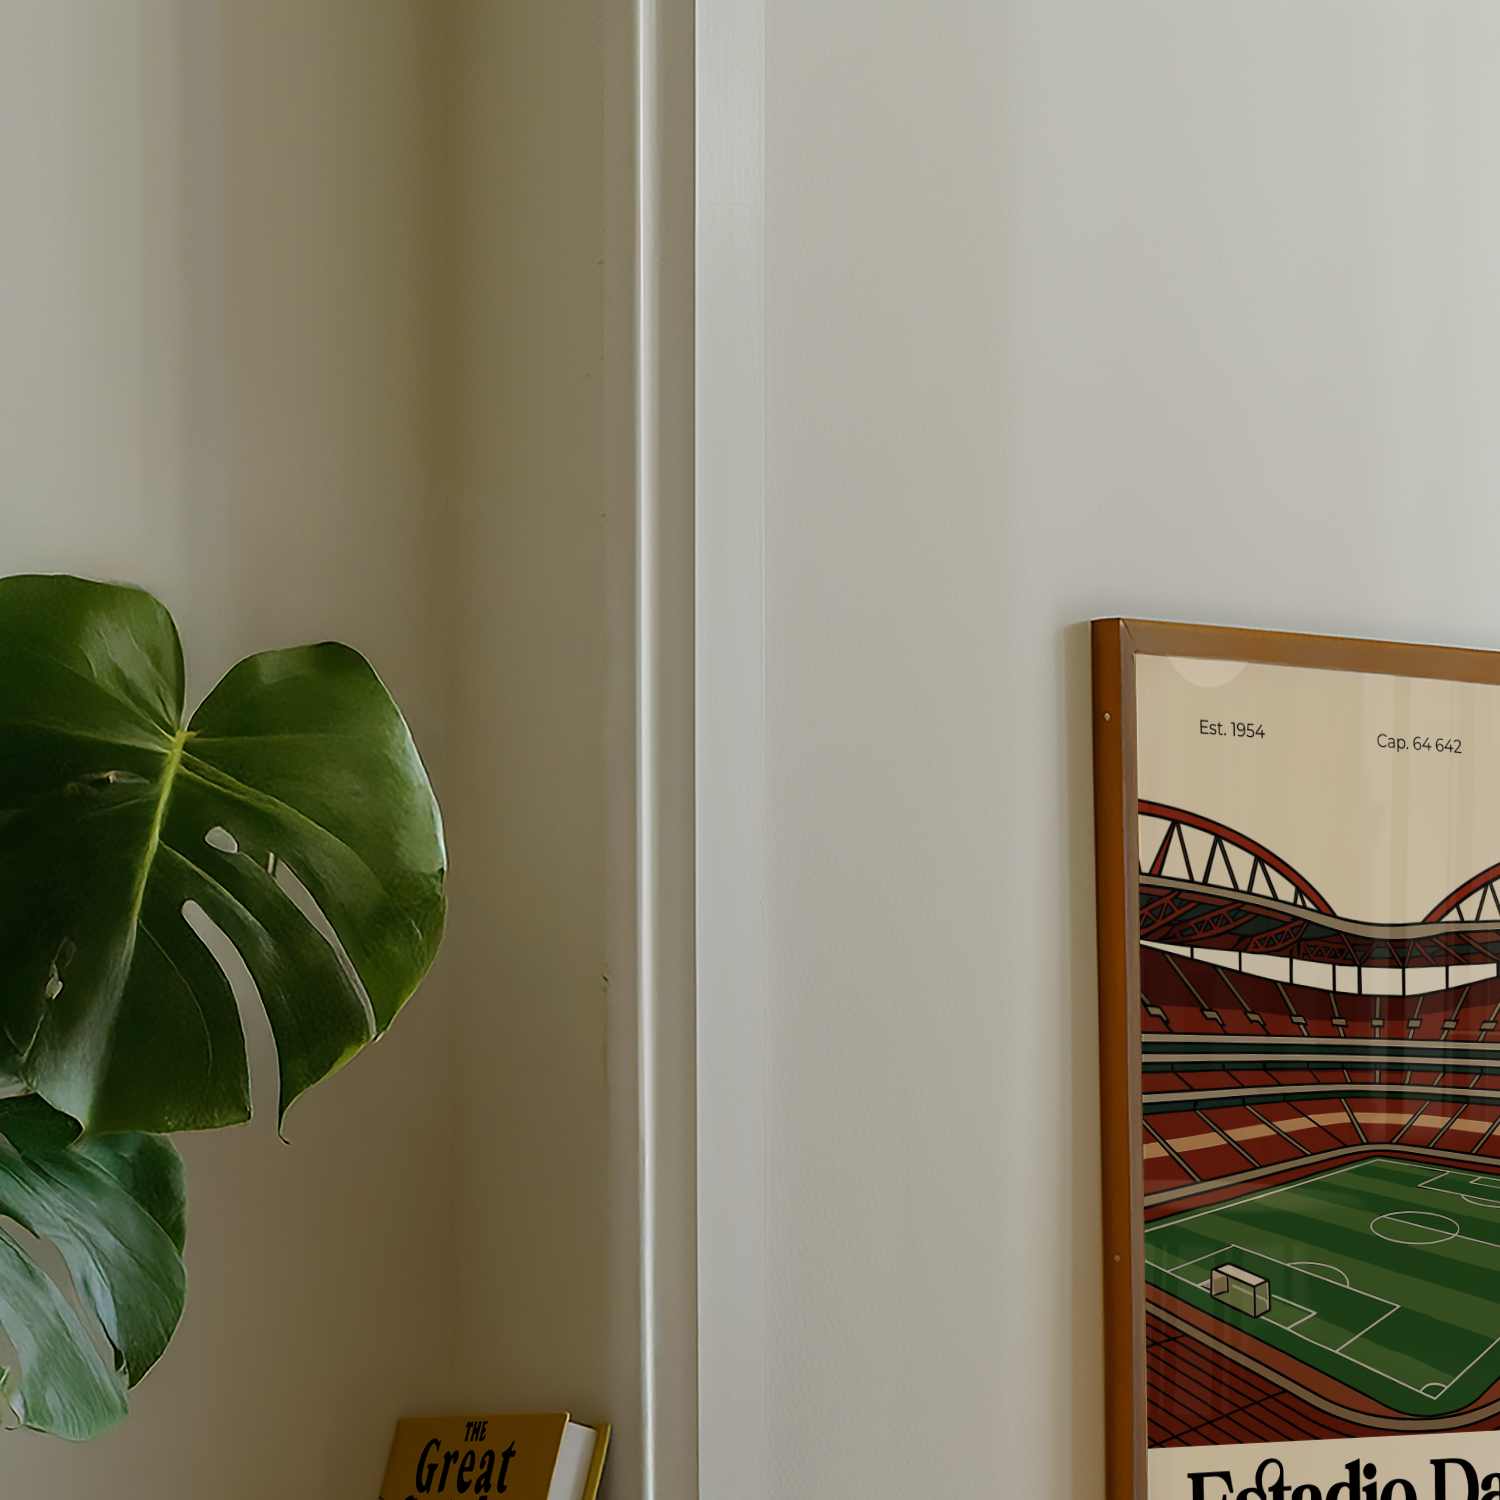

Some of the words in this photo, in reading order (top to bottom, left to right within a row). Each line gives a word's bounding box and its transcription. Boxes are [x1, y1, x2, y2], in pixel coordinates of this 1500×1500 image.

[1199, 718, 1227, 737] Est.
[1230, 721, 1266, 739] 1954
[1376, 733, 1409, 753] Cap.
[1412, 735, 1432, 752] 64
[1435, 737, 1463, 754] 642
[464, 1420, 488, 1442] THE
[415, 1438, 517, 1495] Great
